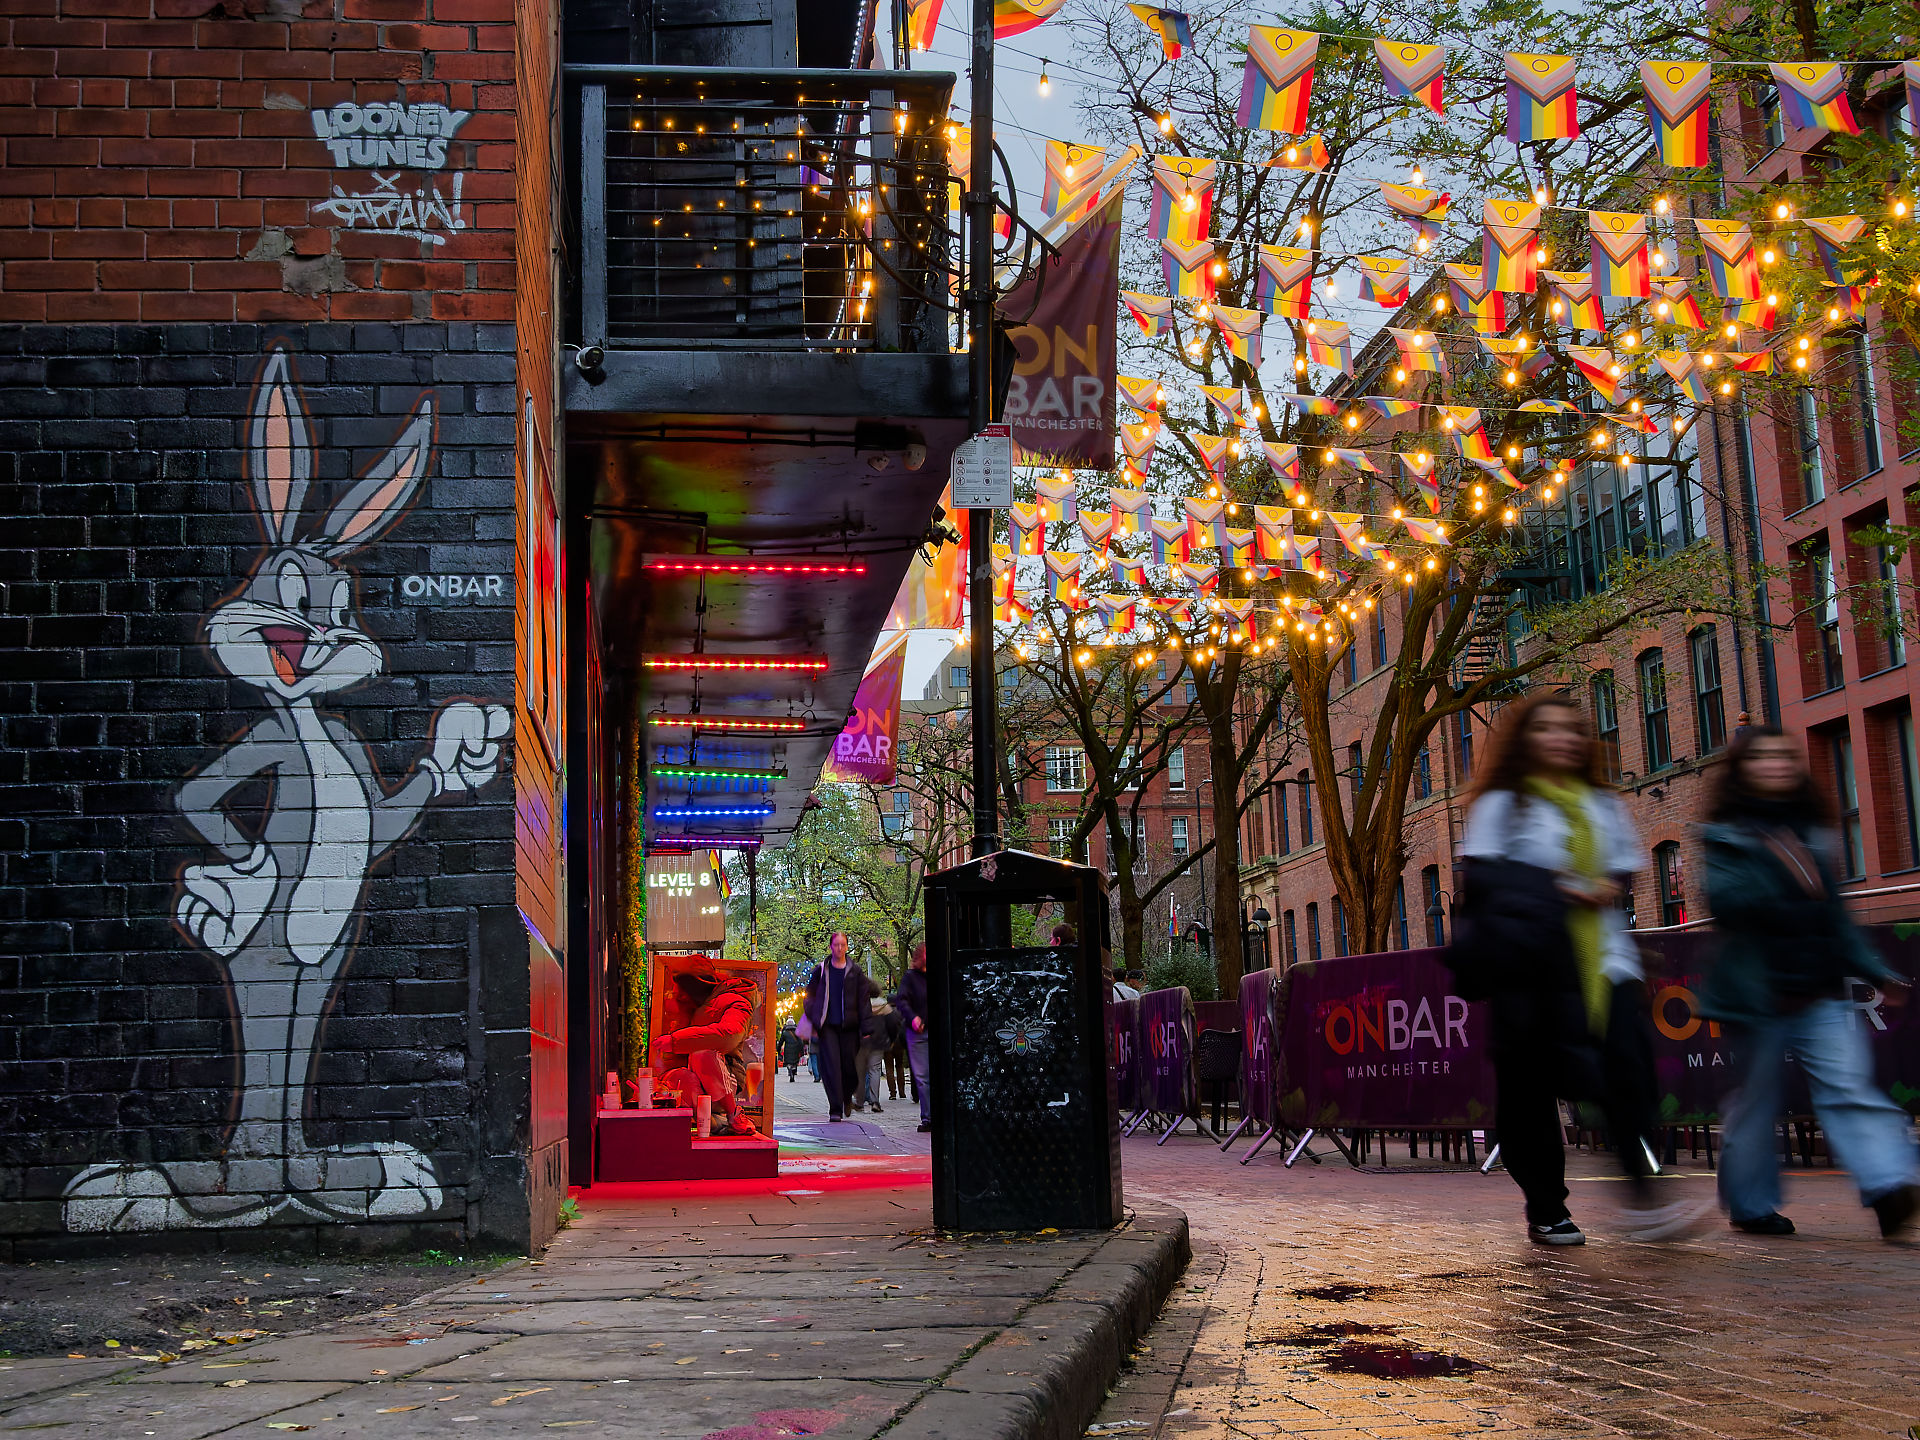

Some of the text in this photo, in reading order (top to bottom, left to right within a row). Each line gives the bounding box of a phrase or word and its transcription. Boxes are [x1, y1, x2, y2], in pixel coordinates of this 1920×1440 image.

[311, 101, 471, 140] LOONEY
[326, 136, 448, 168] TUNES
[1004, 324, 1098, 377] ON
[1003, 376, 1105, 418] BAR
[1001, 414, 1103, 431] MANCHESTER
[403, 575, 504, 597] ONBAR
[843, 707, 891, 736] ON
[836, 733, 892, 758] BAR
[649, 872, 710, 887] LEVEL 8
[668, 888, 692, 897] KTV
[1325, 995, 1469, 1056] ONBAR
